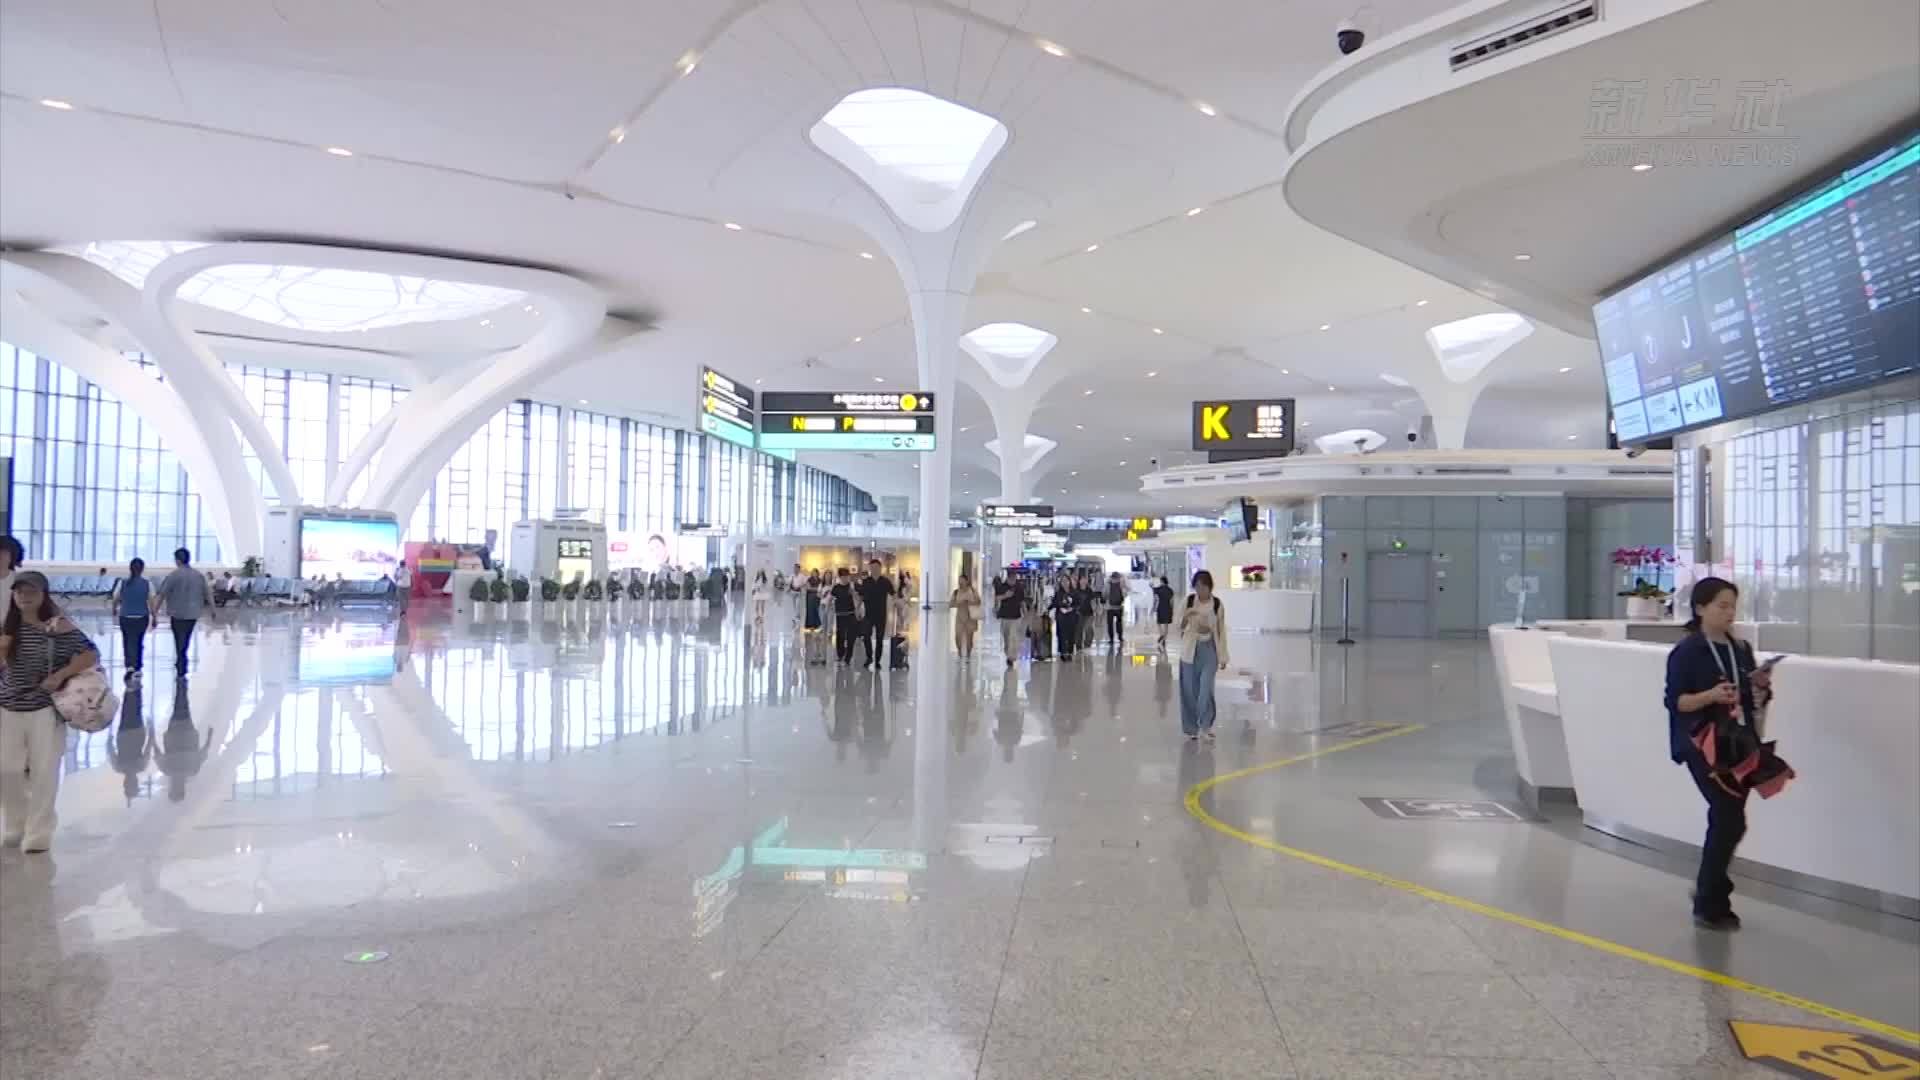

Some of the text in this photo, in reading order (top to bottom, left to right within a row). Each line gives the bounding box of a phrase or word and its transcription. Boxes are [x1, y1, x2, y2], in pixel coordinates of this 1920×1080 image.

[792, 417, 806, 430] N
[843, 417, 855, 430] P
[1203, 405, 1230, 439] K
[1134, 518, 1147, 530] M
[1797, 1044, 1911, 1076] 12
